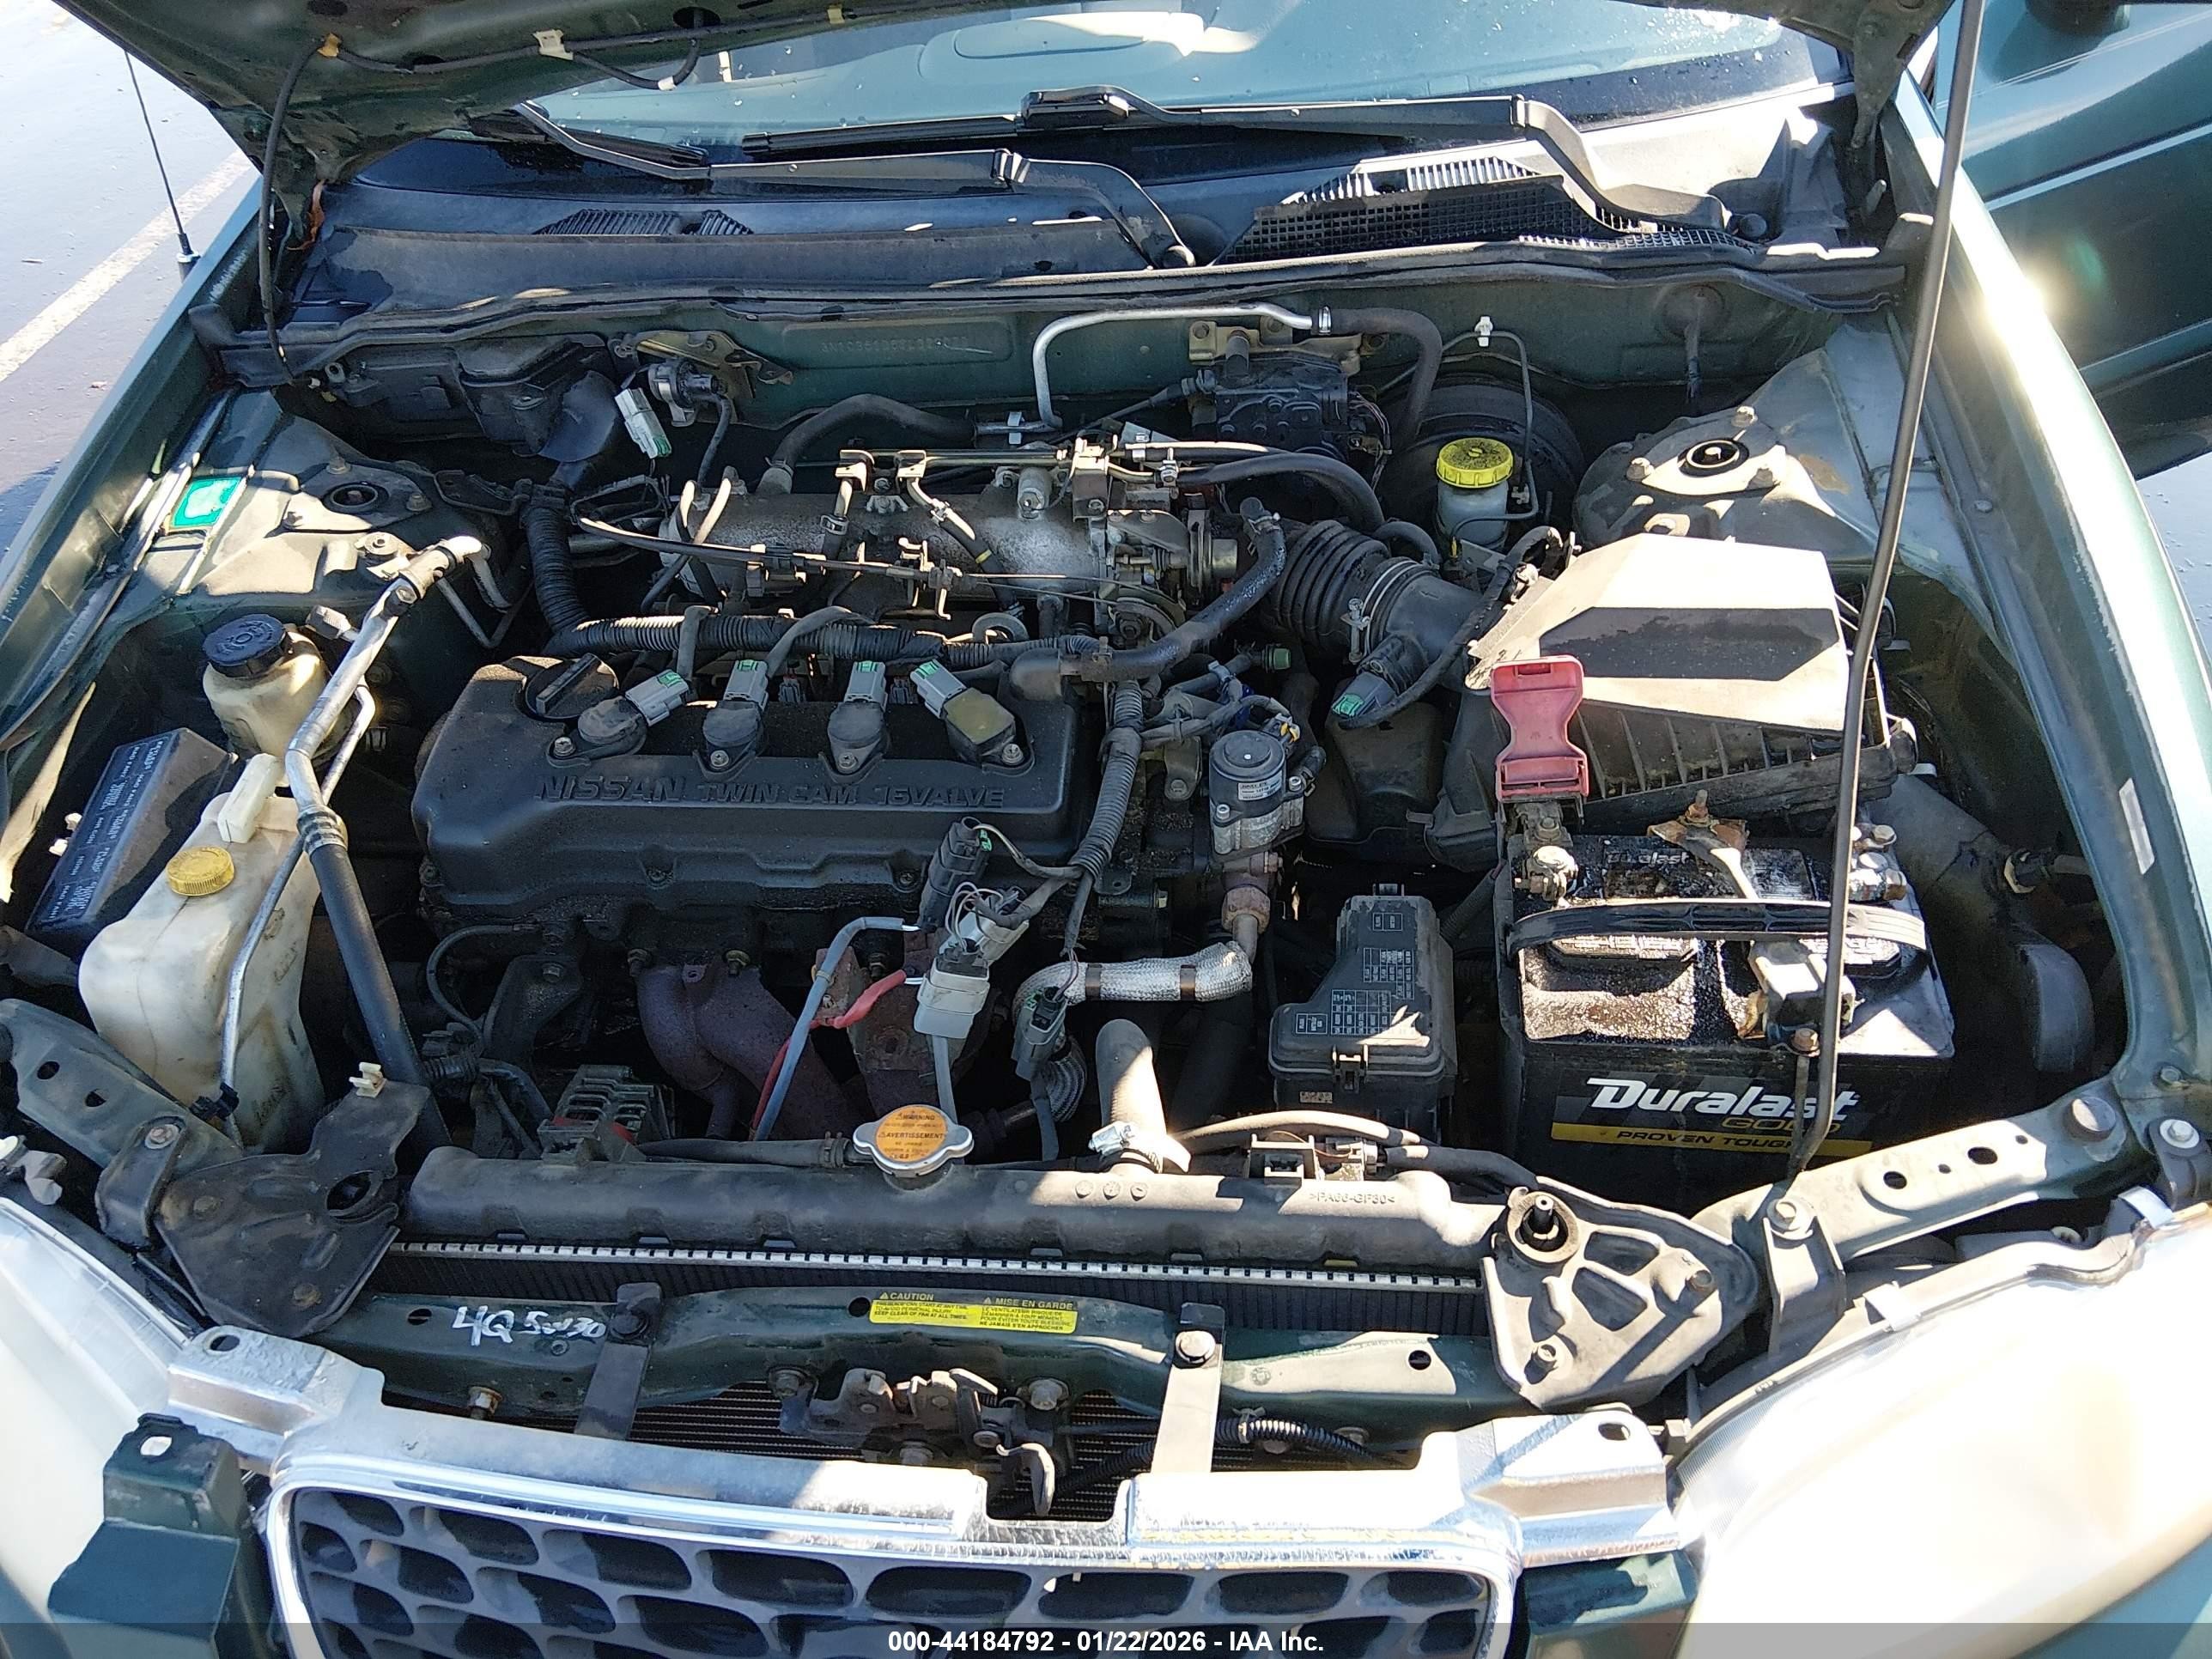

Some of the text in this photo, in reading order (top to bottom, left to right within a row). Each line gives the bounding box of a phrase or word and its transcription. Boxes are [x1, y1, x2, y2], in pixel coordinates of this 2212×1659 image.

[535, 775, 1006, 808] NISSAN TWIN CAM 16VALVE
[1617, 1130, 1715, 1145] PROVEN
[890, 1291, 934, 1301] CAUTION
[994, 1297, 1020, 1306] MISE
[1037, 1301, 1073, 1310] GARDE
